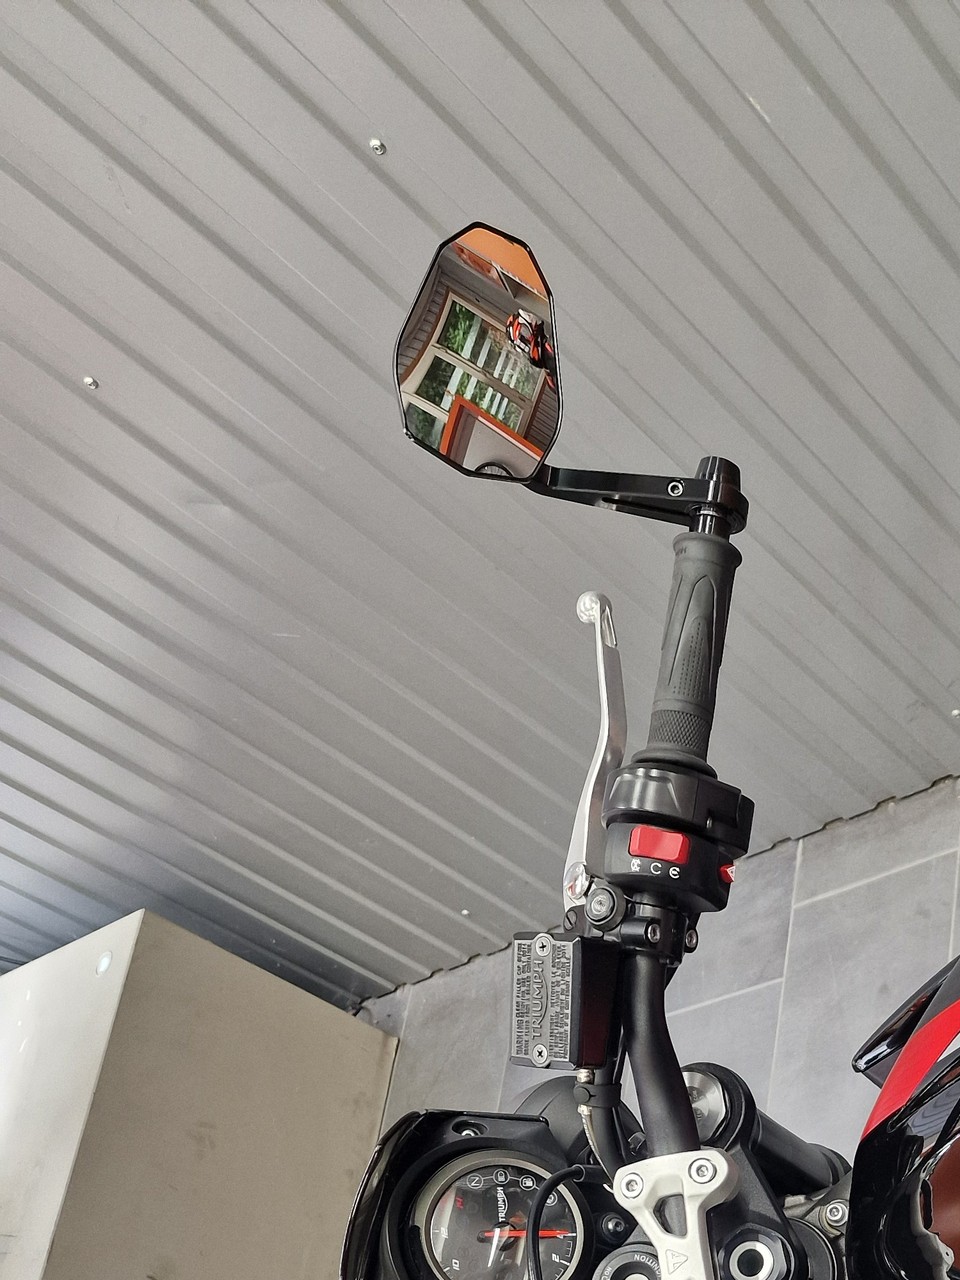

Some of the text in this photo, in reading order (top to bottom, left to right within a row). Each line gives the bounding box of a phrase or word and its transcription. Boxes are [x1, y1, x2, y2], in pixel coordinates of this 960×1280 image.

[531, 959, 548, 1040] TRIUMPH
[497, 1186, 508, 1222] TRIUMPH
[441, 1226, 448, 1238] 12
[552, 1253, 560, 1262] 2
[452, 1258, 459, 1271] 10
[604, 1266, 612, 1276] ON
